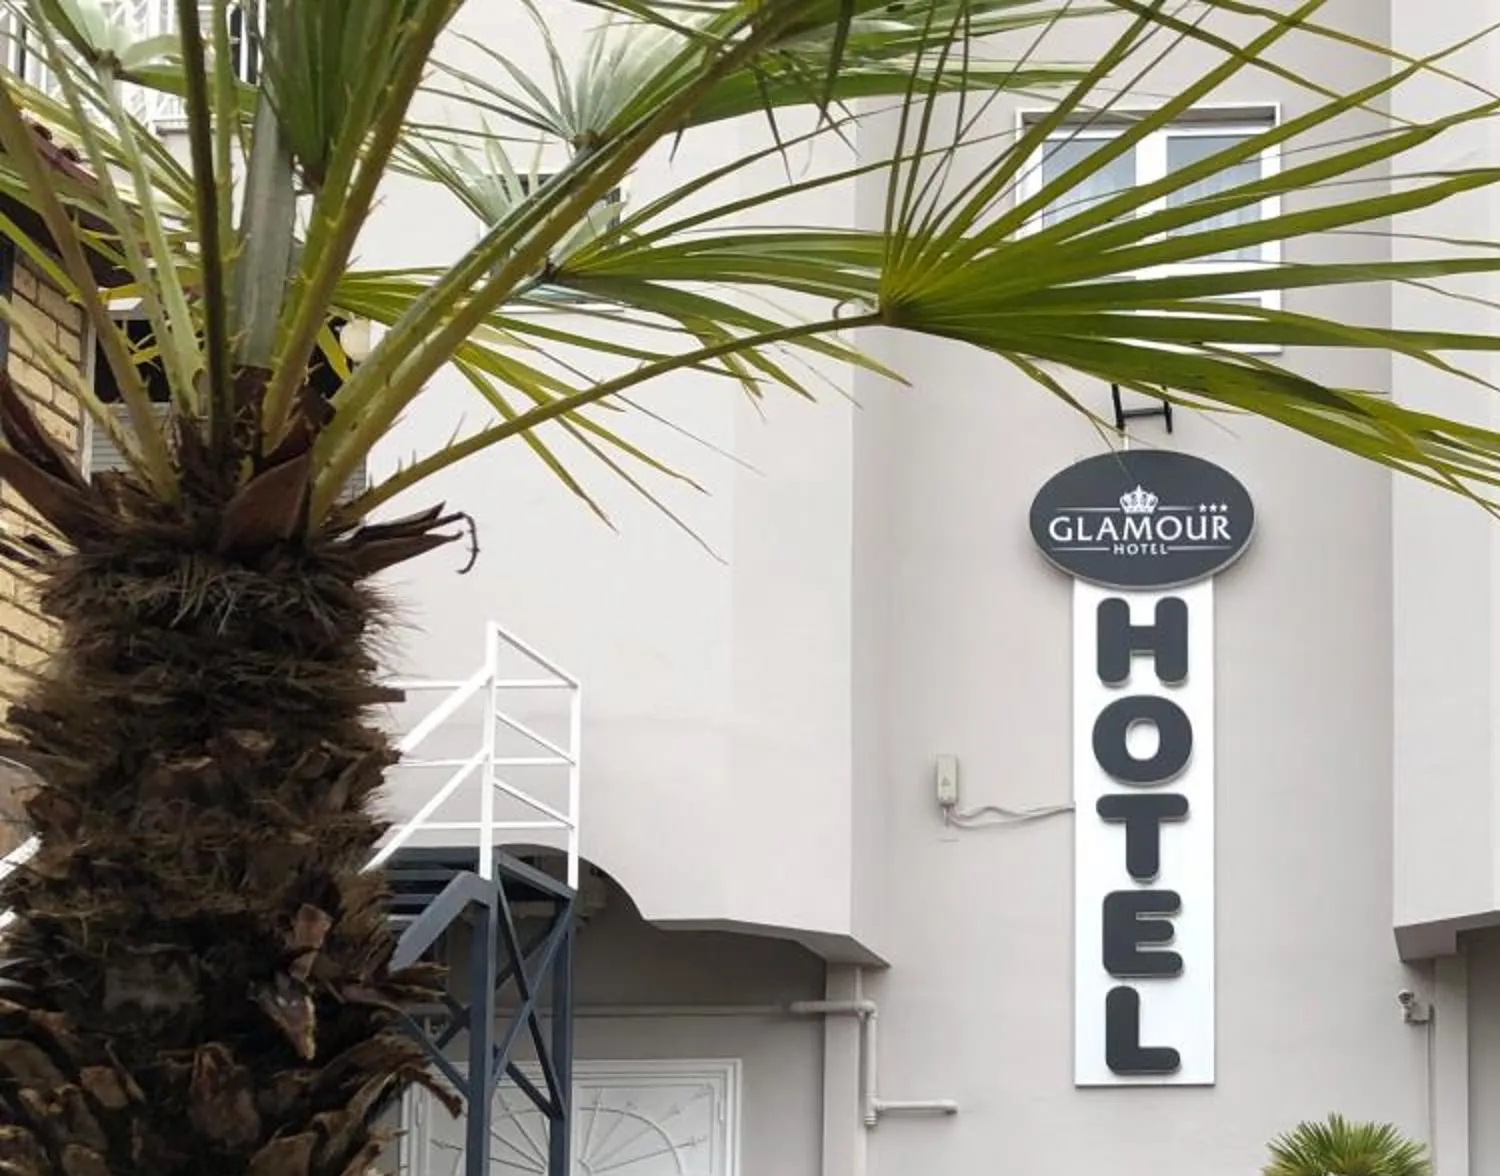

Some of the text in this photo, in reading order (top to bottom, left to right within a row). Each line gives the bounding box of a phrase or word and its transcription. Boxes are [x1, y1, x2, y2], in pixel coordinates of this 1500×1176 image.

[1048, 515, 1232, 542] GLAMOUR
[1113, 543, 1169, 556] HOTEL
[1091, 595, 1194, 1077] HOTEL
